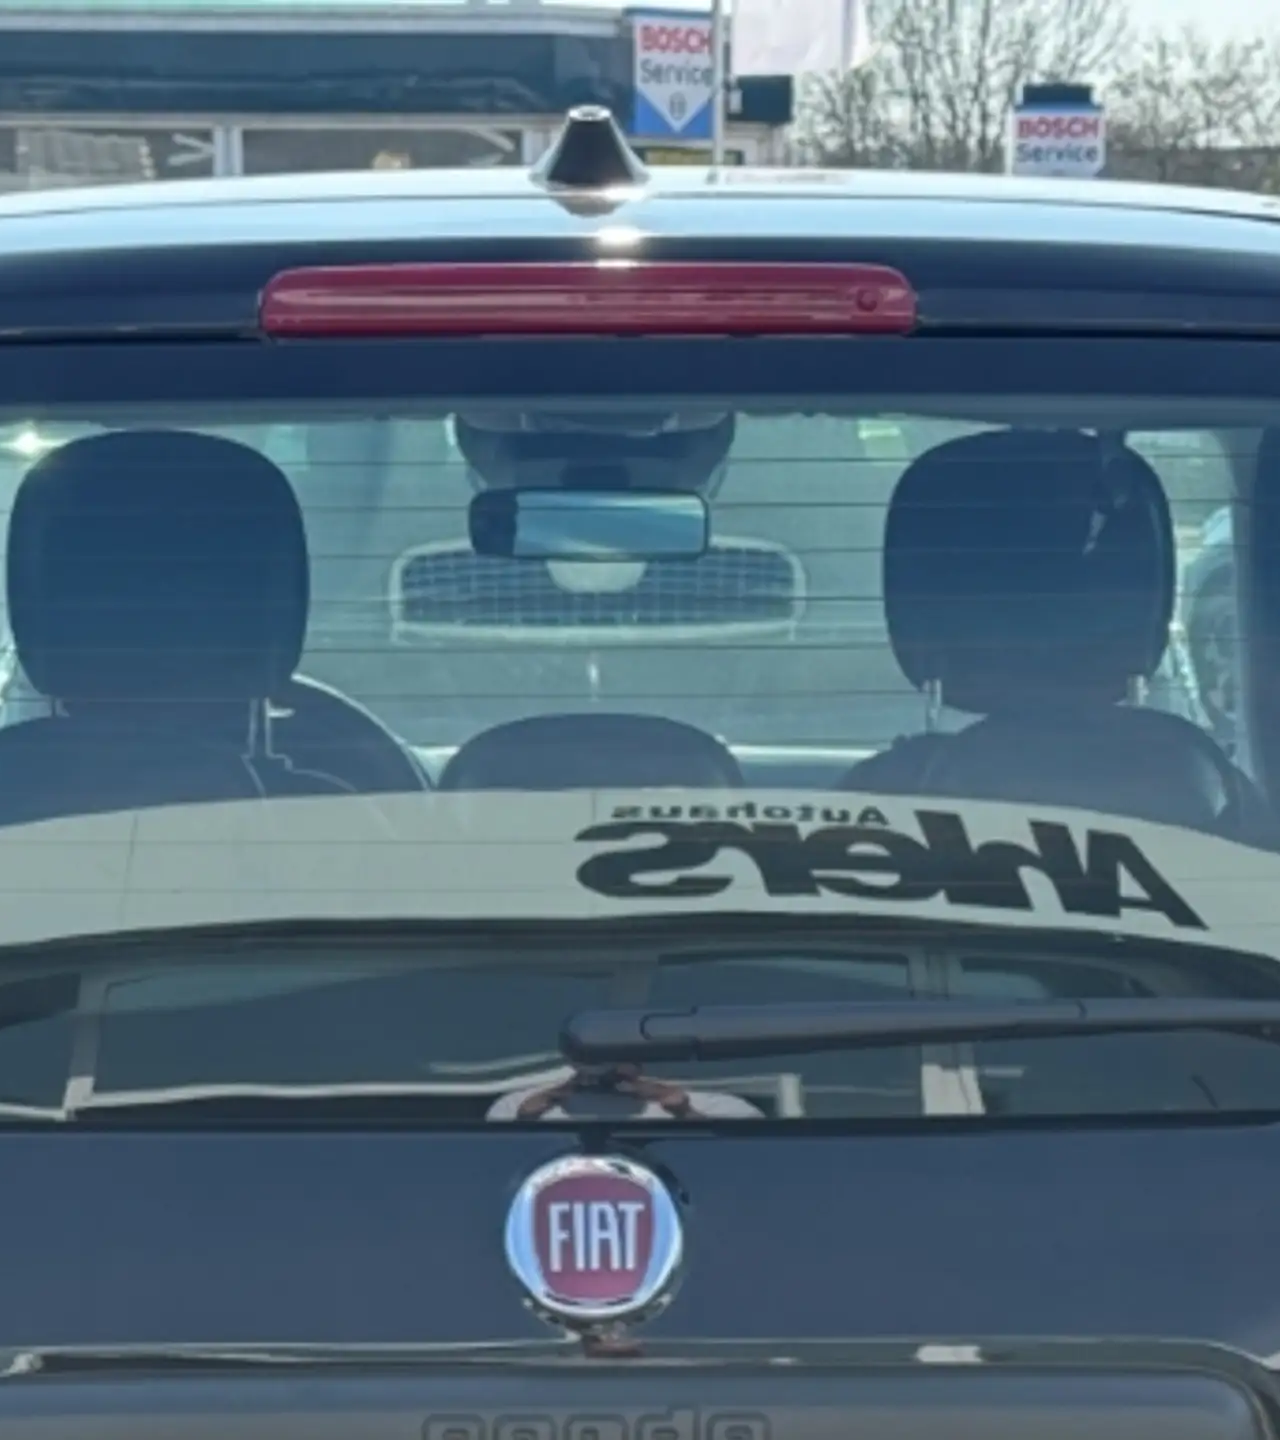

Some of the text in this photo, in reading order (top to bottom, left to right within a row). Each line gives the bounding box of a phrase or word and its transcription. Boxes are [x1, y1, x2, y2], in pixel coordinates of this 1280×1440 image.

[639, 24, 713, 54] BOSCH
[1017, 115, 1099, 140] BOSCH
[1016, 142, 1098, 163] Service
[549, 1201, 646, 1273] FIAT
